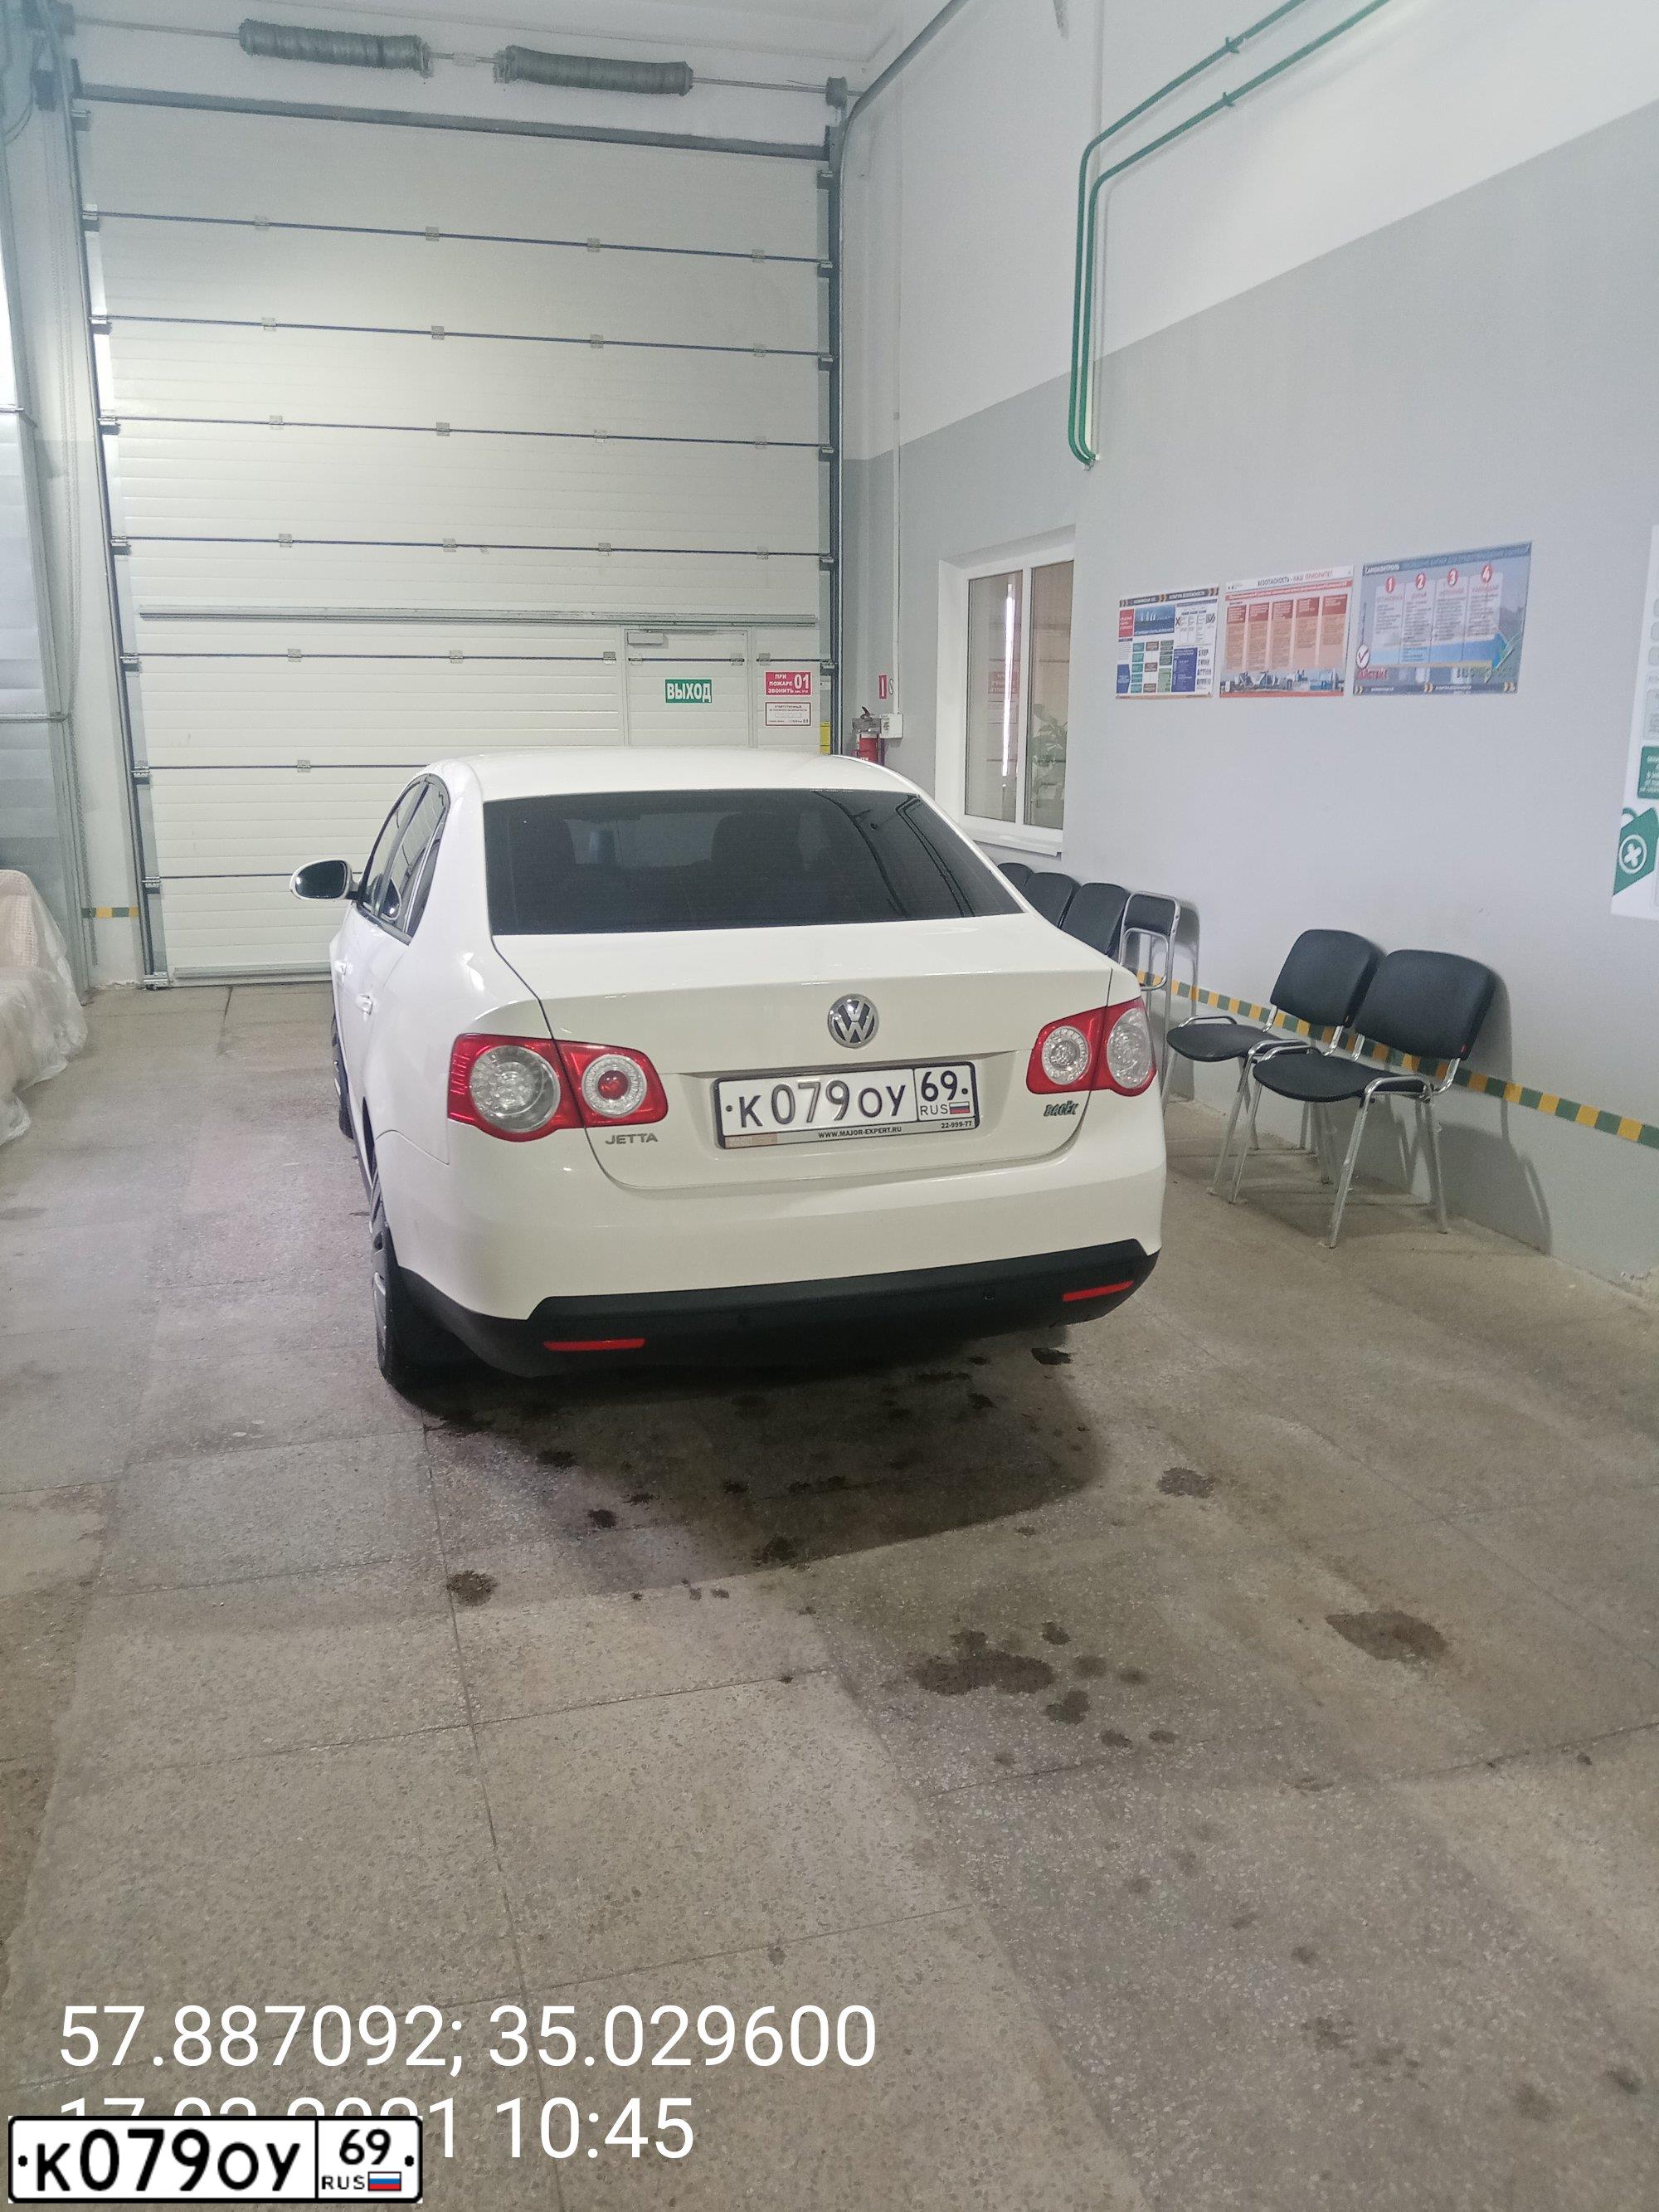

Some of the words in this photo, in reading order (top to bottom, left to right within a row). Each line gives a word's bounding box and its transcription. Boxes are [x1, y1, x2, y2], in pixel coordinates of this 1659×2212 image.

[1450, 570, 1457, 586] 3
[1482, 566, 1491, 583] 4
[1417, 575, 1425, 590] 2
[794, 674, 809, 689] 01
[666, 683, 712, 703] ВЫХОД
[920, 1070, 958, 1102] 69
[920, 1104, 949, 1116] RUS
[941, 1120, 972, 1129] 22-999-77
[605, 1133, 659, 1145] JETTA
[818, 1127, 902, 1138] WWW.MAJOR-EXPERT.RU
